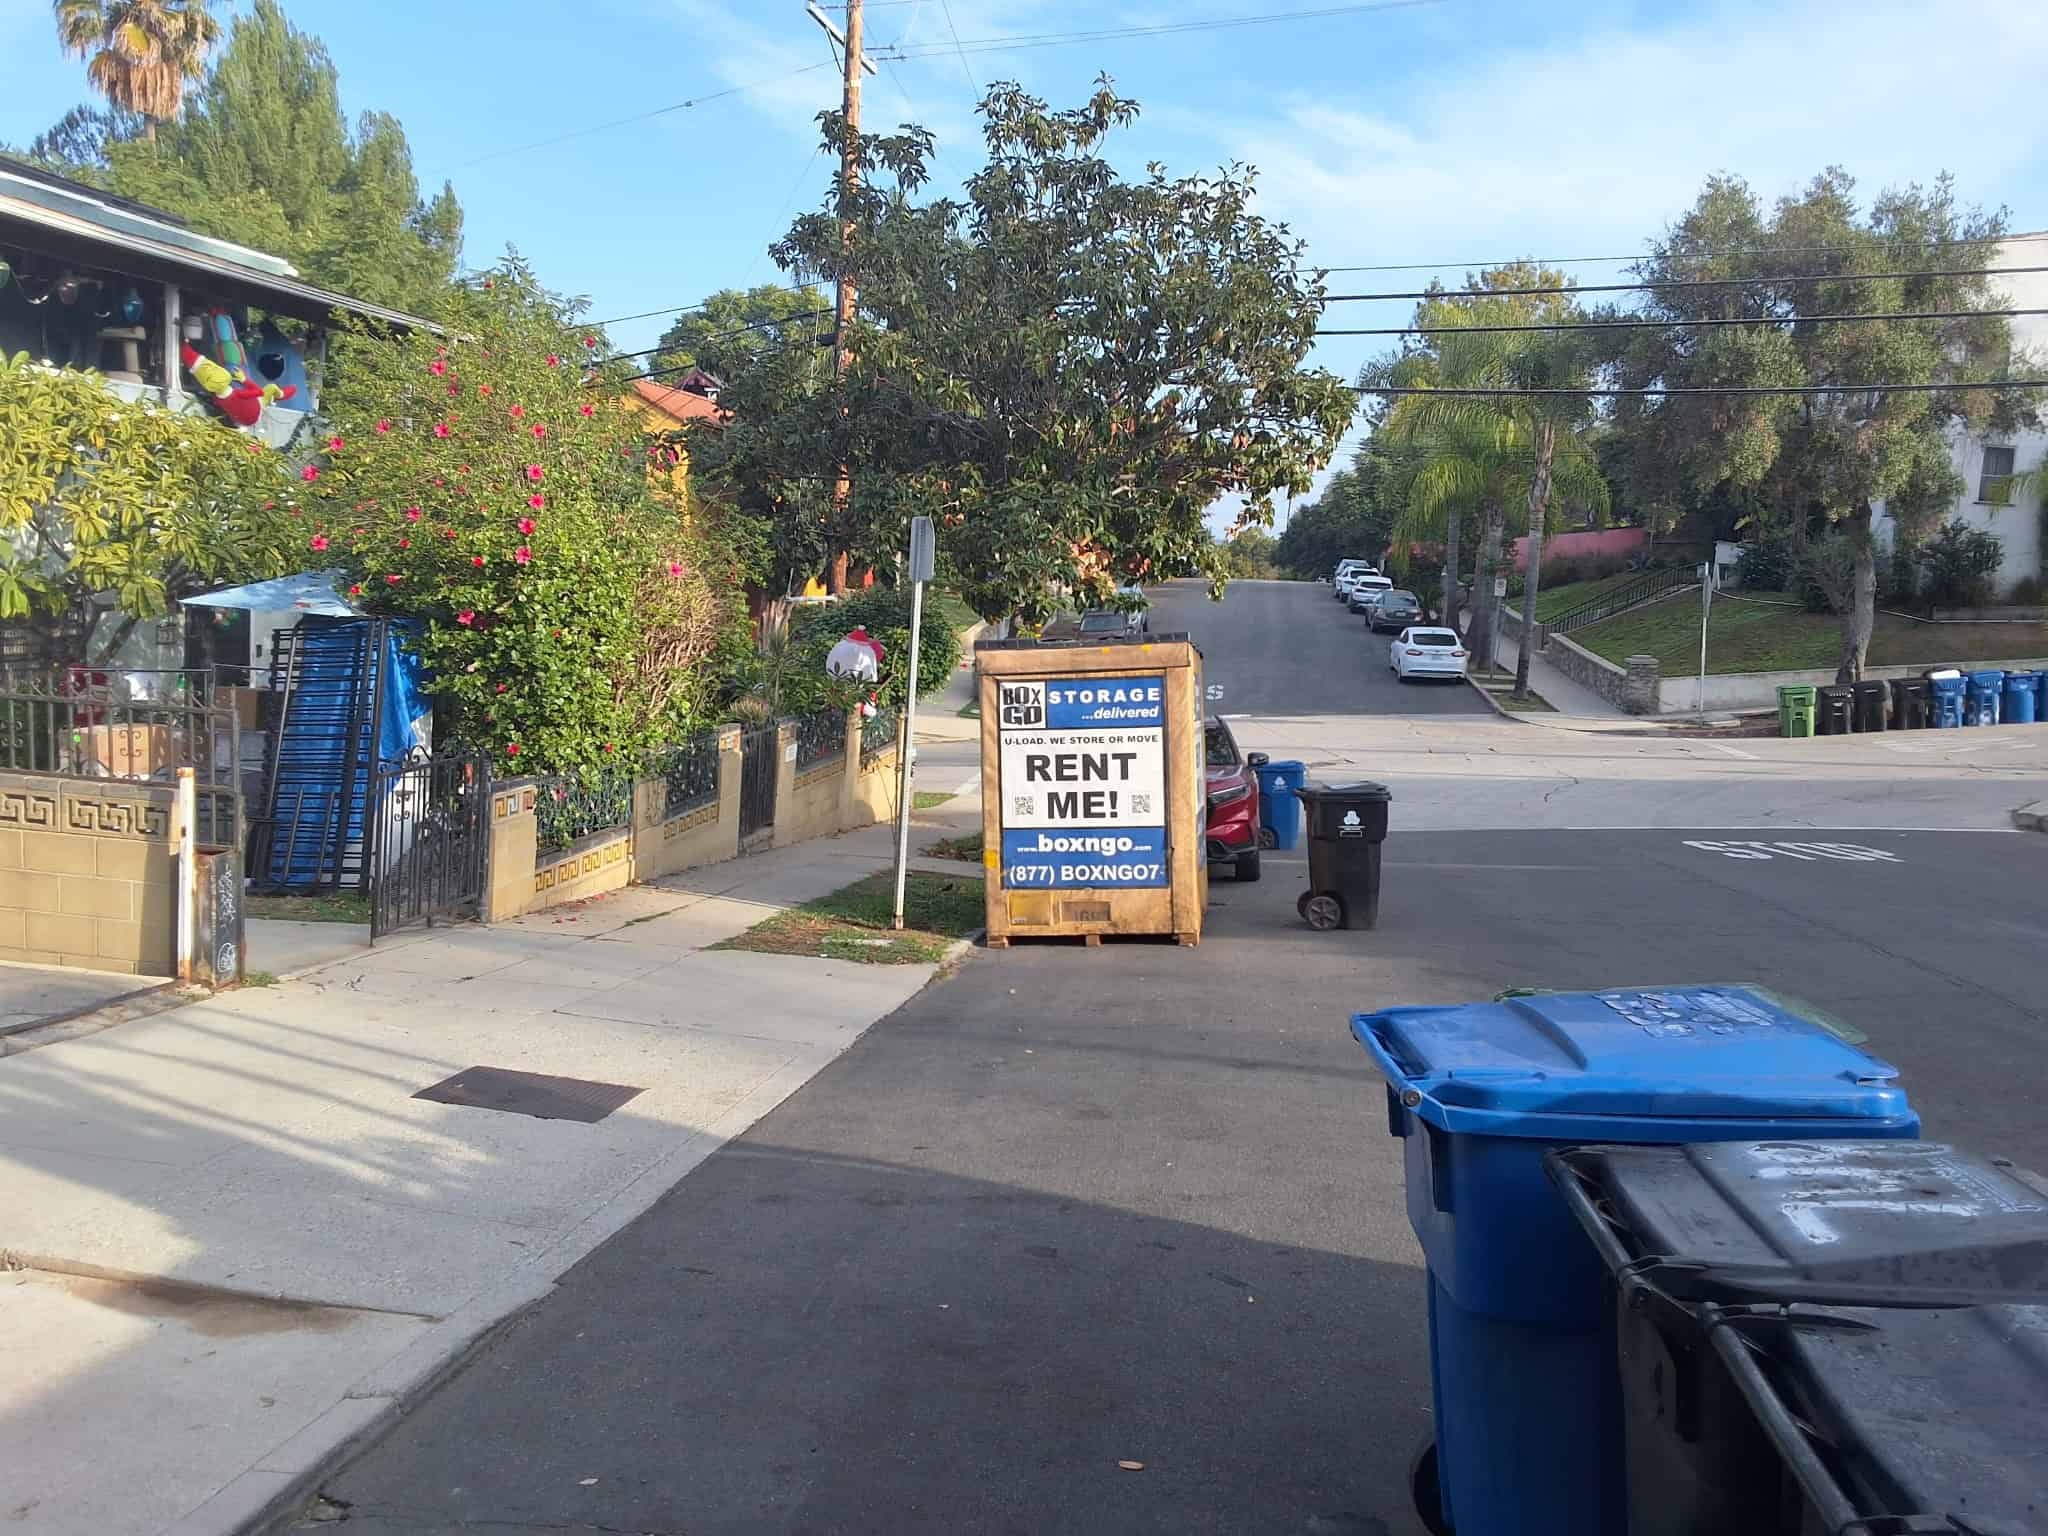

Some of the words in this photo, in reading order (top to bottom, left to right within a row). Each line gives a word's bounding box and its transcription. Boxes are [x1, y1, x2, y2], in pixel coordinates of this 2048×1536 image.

[1003, 687, 1041, 706] BOX
[1049, 688, 1160, 704] STORAGE
[1003, 706, 1042, 725] GO
[1050, 737, 1066, 745] WE
[1069, 736, 1105, 745] STORE
[1108, 735, 1124, 744] OR
[1127, 735, 1159, 743] MOVE
[1026, 753, 1137, 781] RENT
[1047, 791, 1119, 819] ME!
[1682, 840, 1905, 863] STOP
[1009, 865, 1055, 885] (877)
[1061, 865, 1160, 881] BOXNGO7
